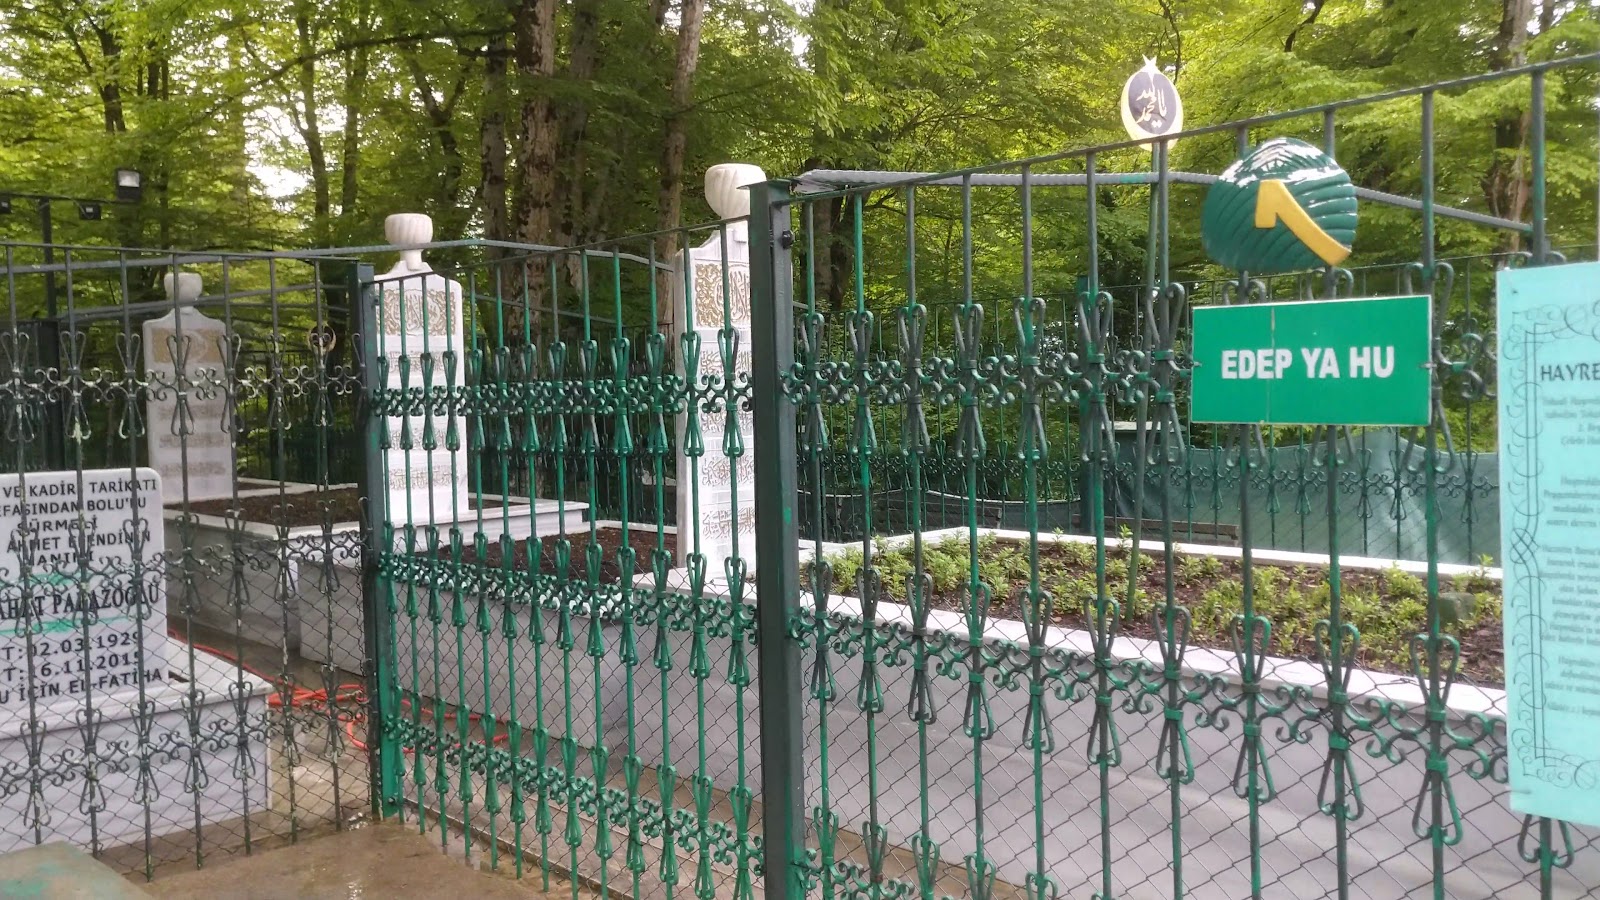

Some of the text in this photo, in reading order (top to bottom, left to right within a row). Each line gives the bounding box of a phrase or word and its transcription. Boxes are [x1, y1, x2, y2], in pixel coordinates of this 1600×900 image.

[1221, 345, 1395, 380] EDEP YA HU
[1540, 362, 1600, 381] HAYRE
[2, 485, 21, 499] VE
[89, 477, 157, 494] TARİKATI
[0, 501, 81, 517] FASINDAN
